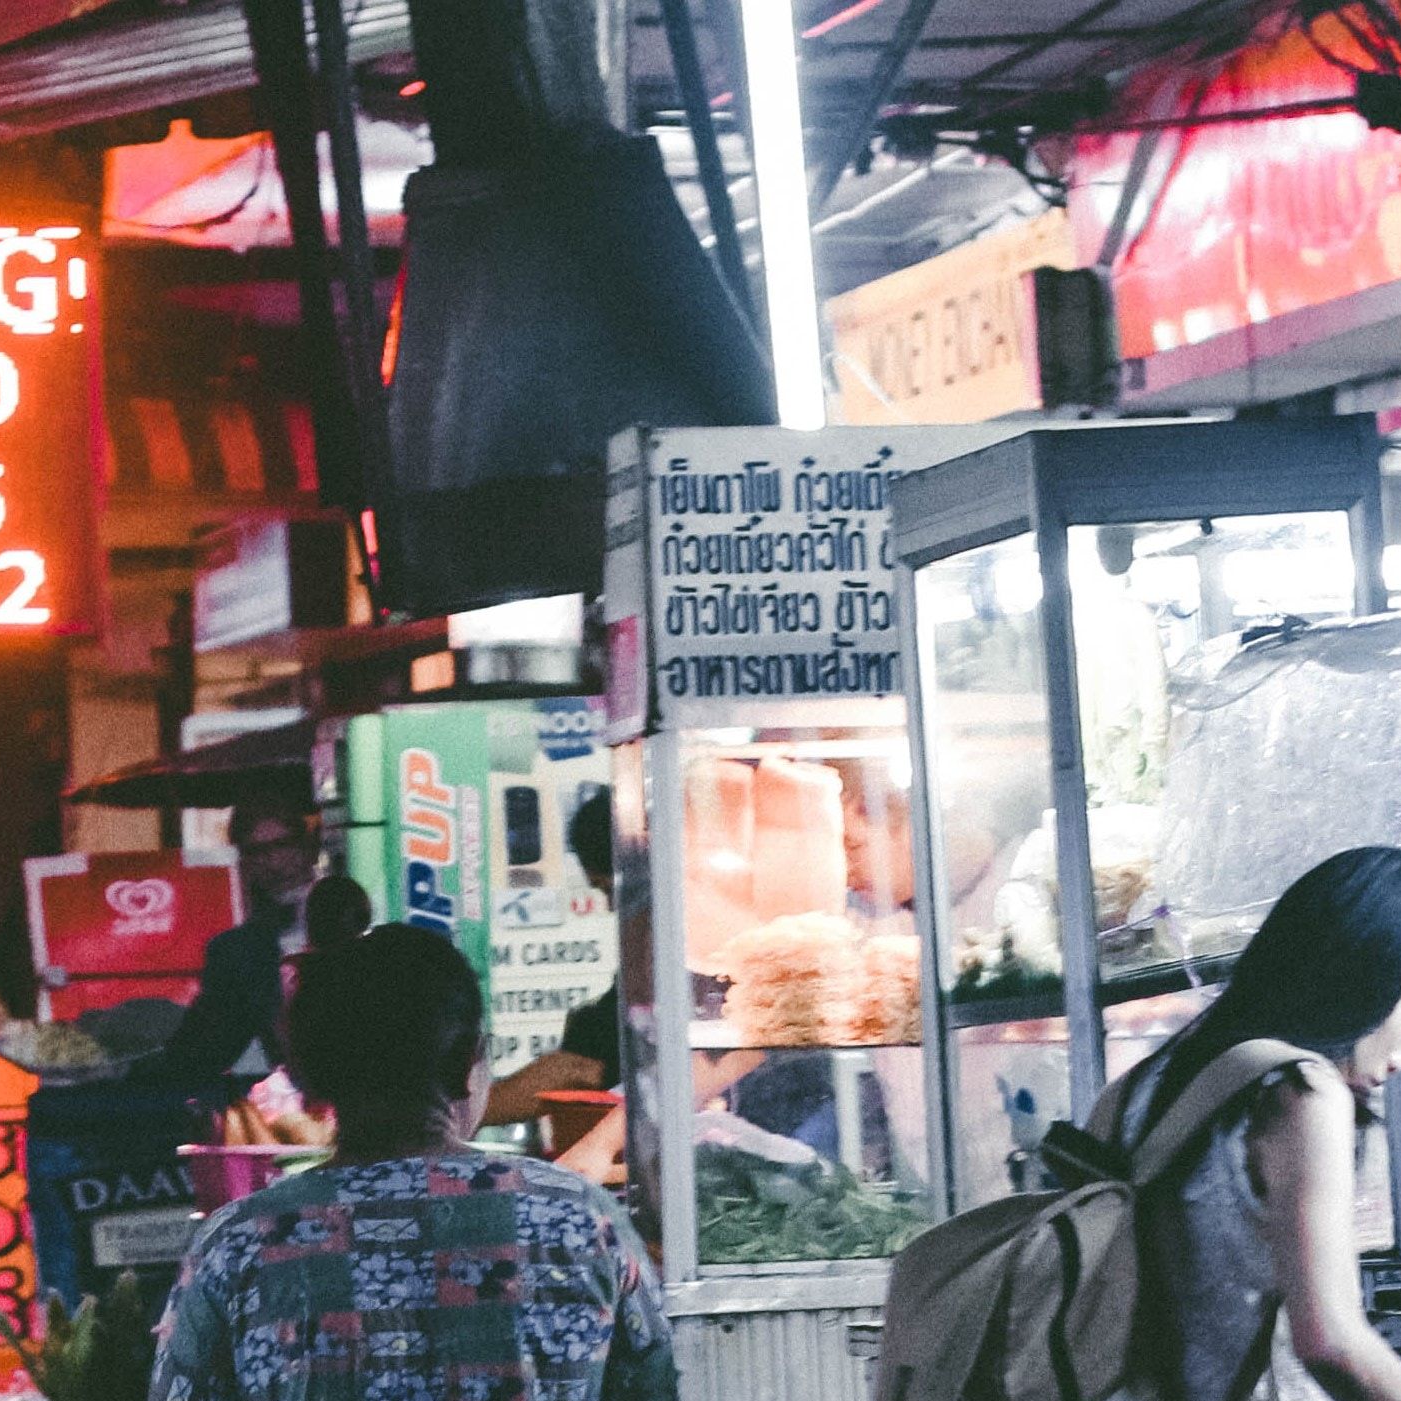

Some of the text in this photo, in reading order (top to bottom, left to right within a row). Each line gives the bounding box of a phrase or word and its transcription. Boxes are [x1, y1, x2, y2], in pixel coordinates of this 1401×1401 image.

[659, 457, 781, 515] เย็นตาโฟ
[661, 514, 867, 576] ก๋วยเตี๋ยวคั่วไก่
[665, 583, 821, 636] ข้าวไข่เจียว
[522, 939, 601, 966] CARDS
[489, 986, 588, 1013] NTERNET
